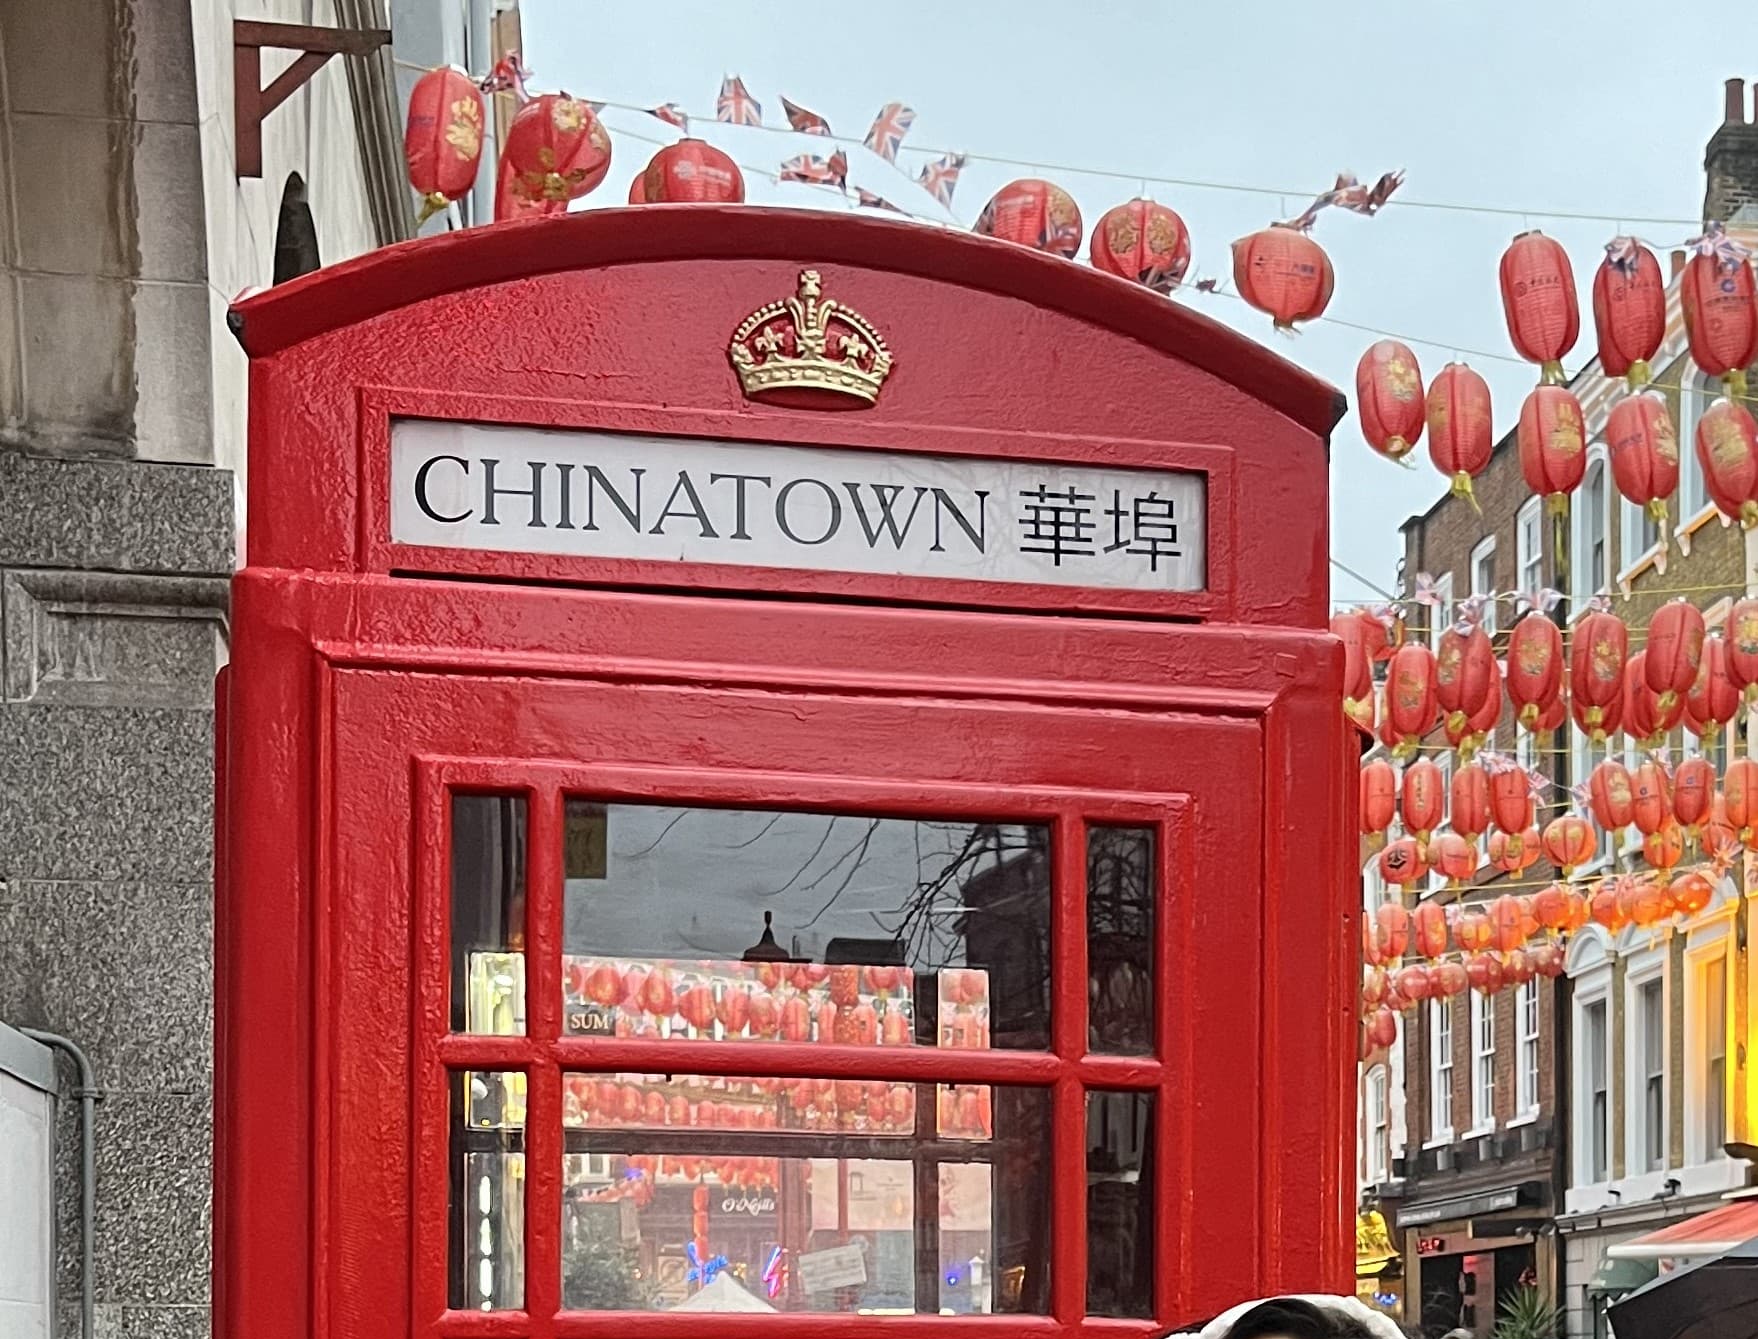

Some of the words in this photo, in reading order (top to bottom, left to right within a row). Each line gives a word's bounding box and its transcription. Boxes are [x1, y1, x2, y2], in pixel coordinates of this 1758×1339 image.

[413, 455, 988, 554] CHINATOWN
[1018, 482, 1183, 573] 華埠
[570, 1013, 609, 1030] SUM
